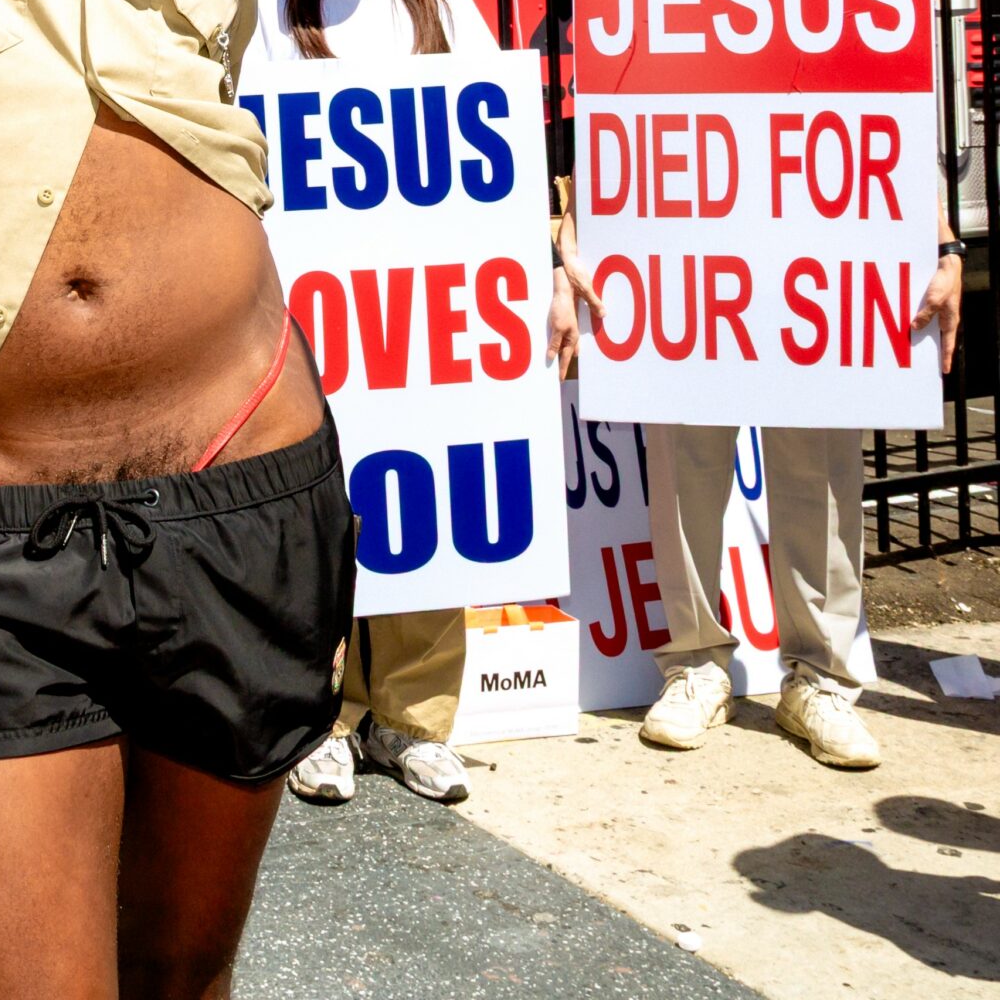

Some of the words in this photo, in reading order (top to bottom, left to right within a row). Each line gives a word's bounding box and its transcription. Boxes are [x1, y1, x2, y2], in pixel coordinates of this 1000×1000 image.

[590, 112, 739, 219] DIED
[770, 111, 904, 221] FOR
[289, 257, 532, 396] OVES
[592, 254, 758, 362] OUR
[780, 256, 912, 368] SIN
[349, 439, 534, 575] OU
[480, 669, 547, 692] MoMA
